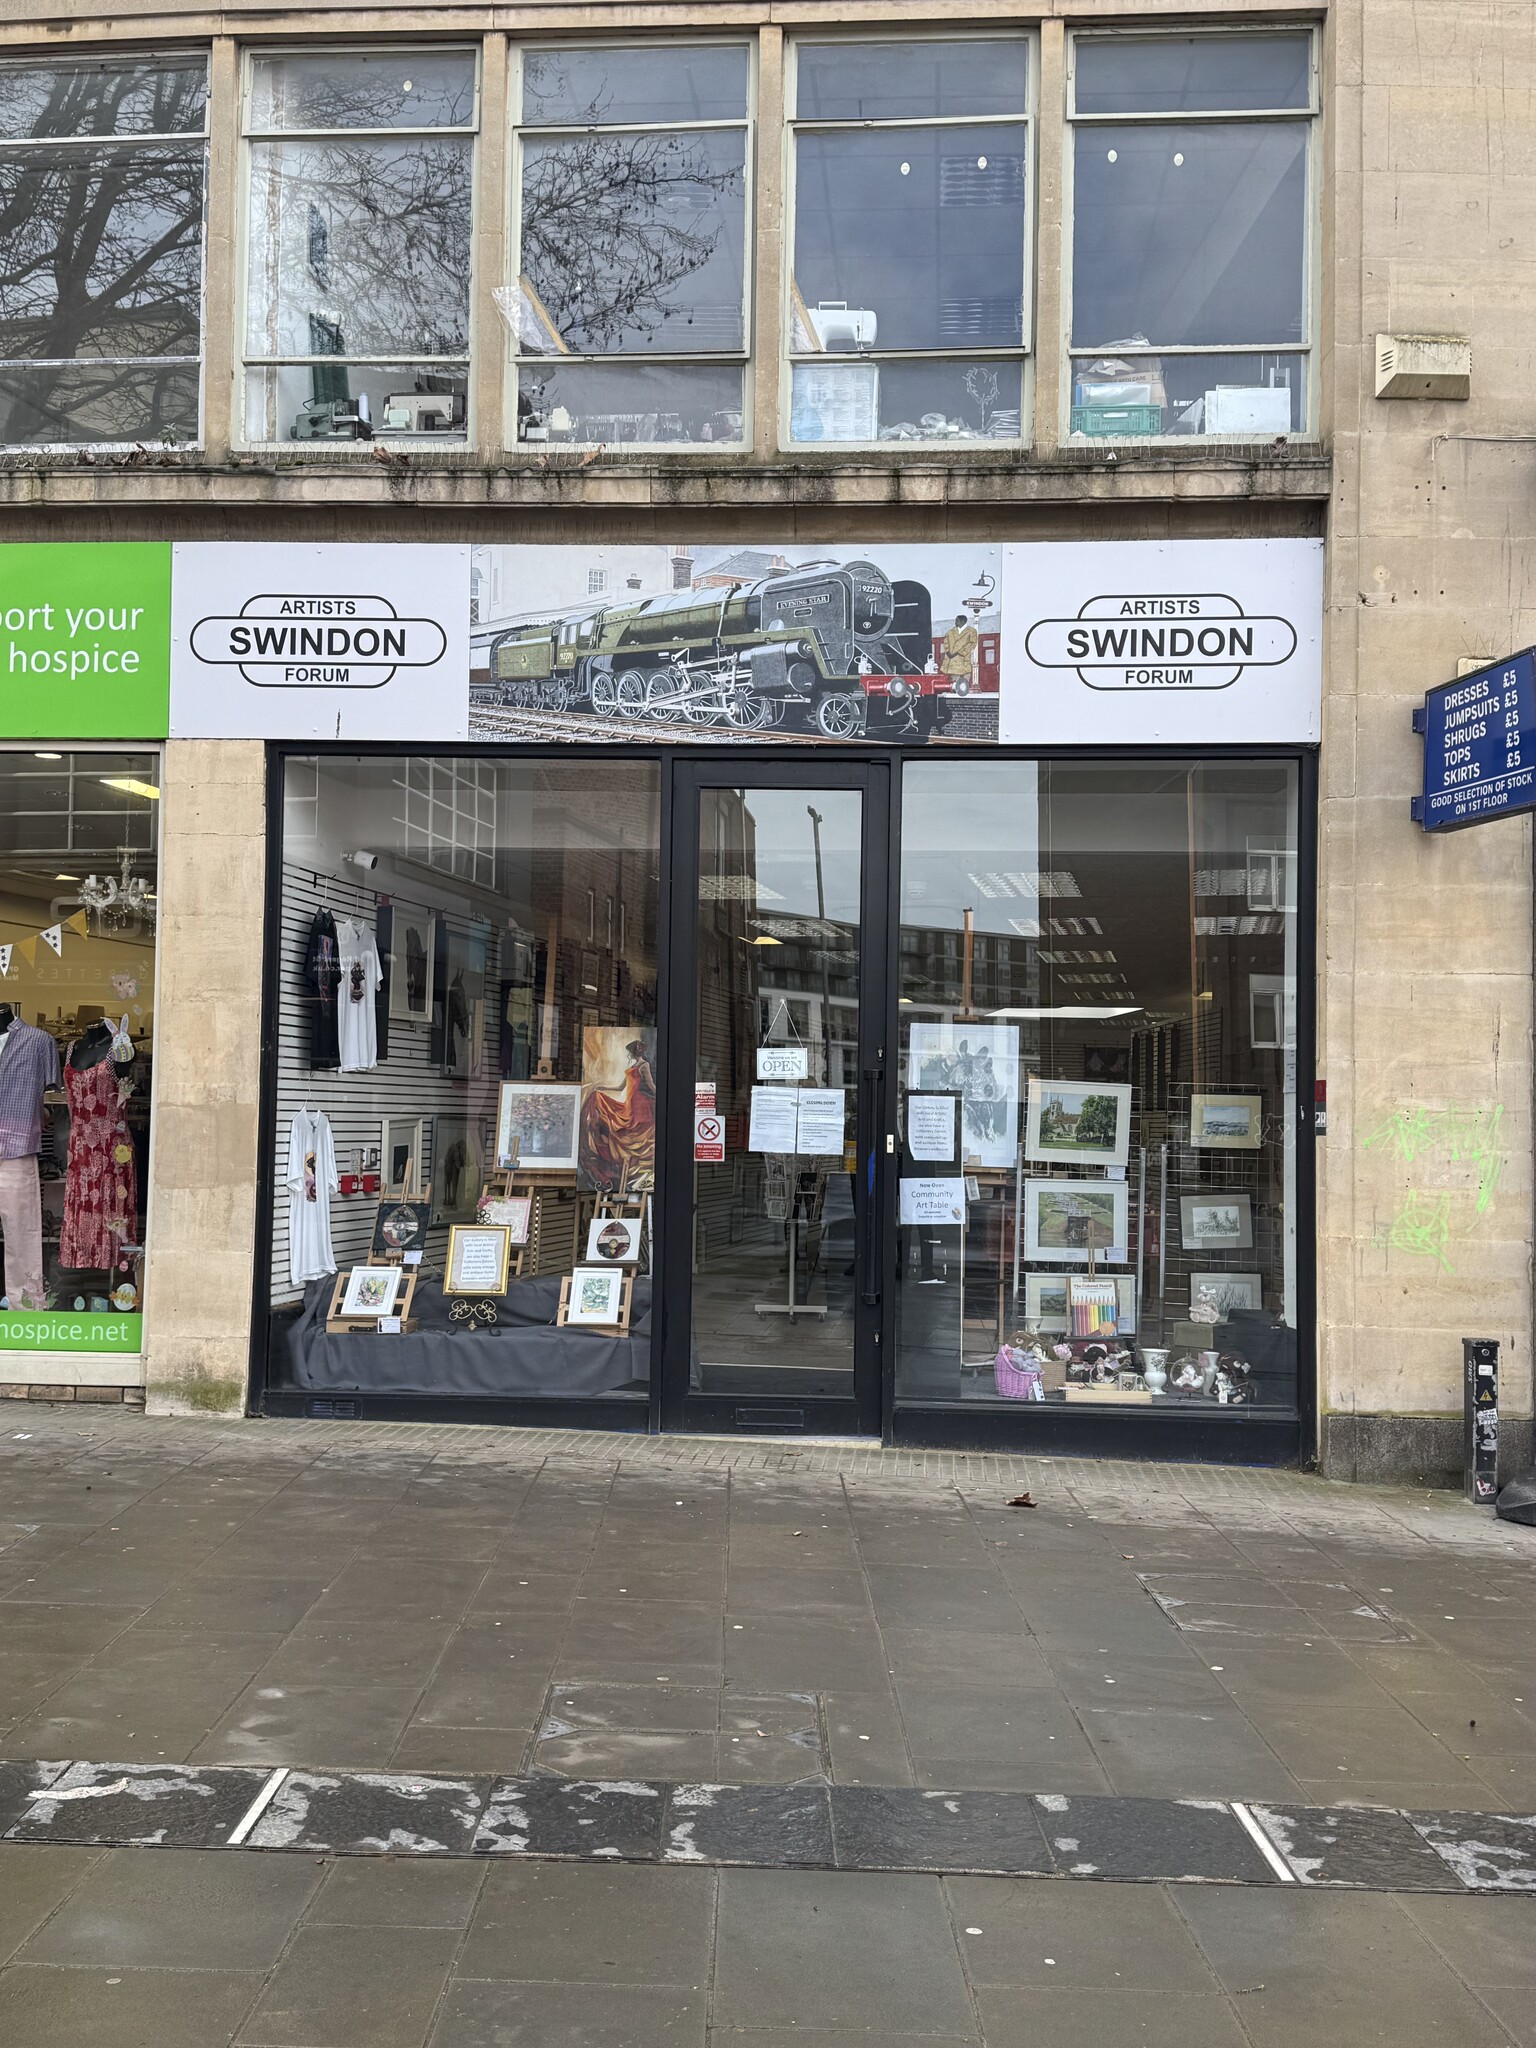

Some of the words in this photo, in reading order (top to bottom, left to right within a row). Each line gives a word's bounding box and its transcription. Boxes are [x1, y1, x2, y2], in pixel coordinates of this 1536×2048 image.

[780, 599, 808, 608] EVENING
[809, 596, 827, 604] STAR
[862, 585, 883, 594] 92220
[0, 603, 55, 631] ort
[65, 608, 144, 638] your
[279, 600, 356, 616] ARTISTS
[1120, 600, 1200, 616] ARTISTS
[228, 626, 406, 657] SWINDON
[1066, 627, 1253, 658] SWINDON
[9, 641, 140, 680] hospice
[284, 667, 350, 682] FORUM
[1124, 669, 1194, 684] FORUM
[1444, 680, 1489, 711] DRESSES
[1502, 670, 1517, 688] £5
[1444, 696, 1501, 730] JUMPSUITS
[1504, 690, 1518, 708] £5
[1444, 721, 1487, 749] SHRUGS
[1505, 710, 1519, 728] £5
[1444, 746, 1471, 767] TOPS
[1506, 730, 1520, 748] £5
[1443, 762, 1480, 786] SKIRTS
[1506, 750, 1521, 768] £5
[1431, 795, 1452, 808] GOOD
[1454, 784, 1493, 803] SELECTION
[1495, 780, 1506, 792] OF
[1507, 772, 1532, 789] STOCK
[1455, 803, 1466, 814] ON
[1468, 799, 1481, 812] 1ST
[1483, 793, 1508, 809] FLOOR
[762, 1060, 802, 1072] OPEN
